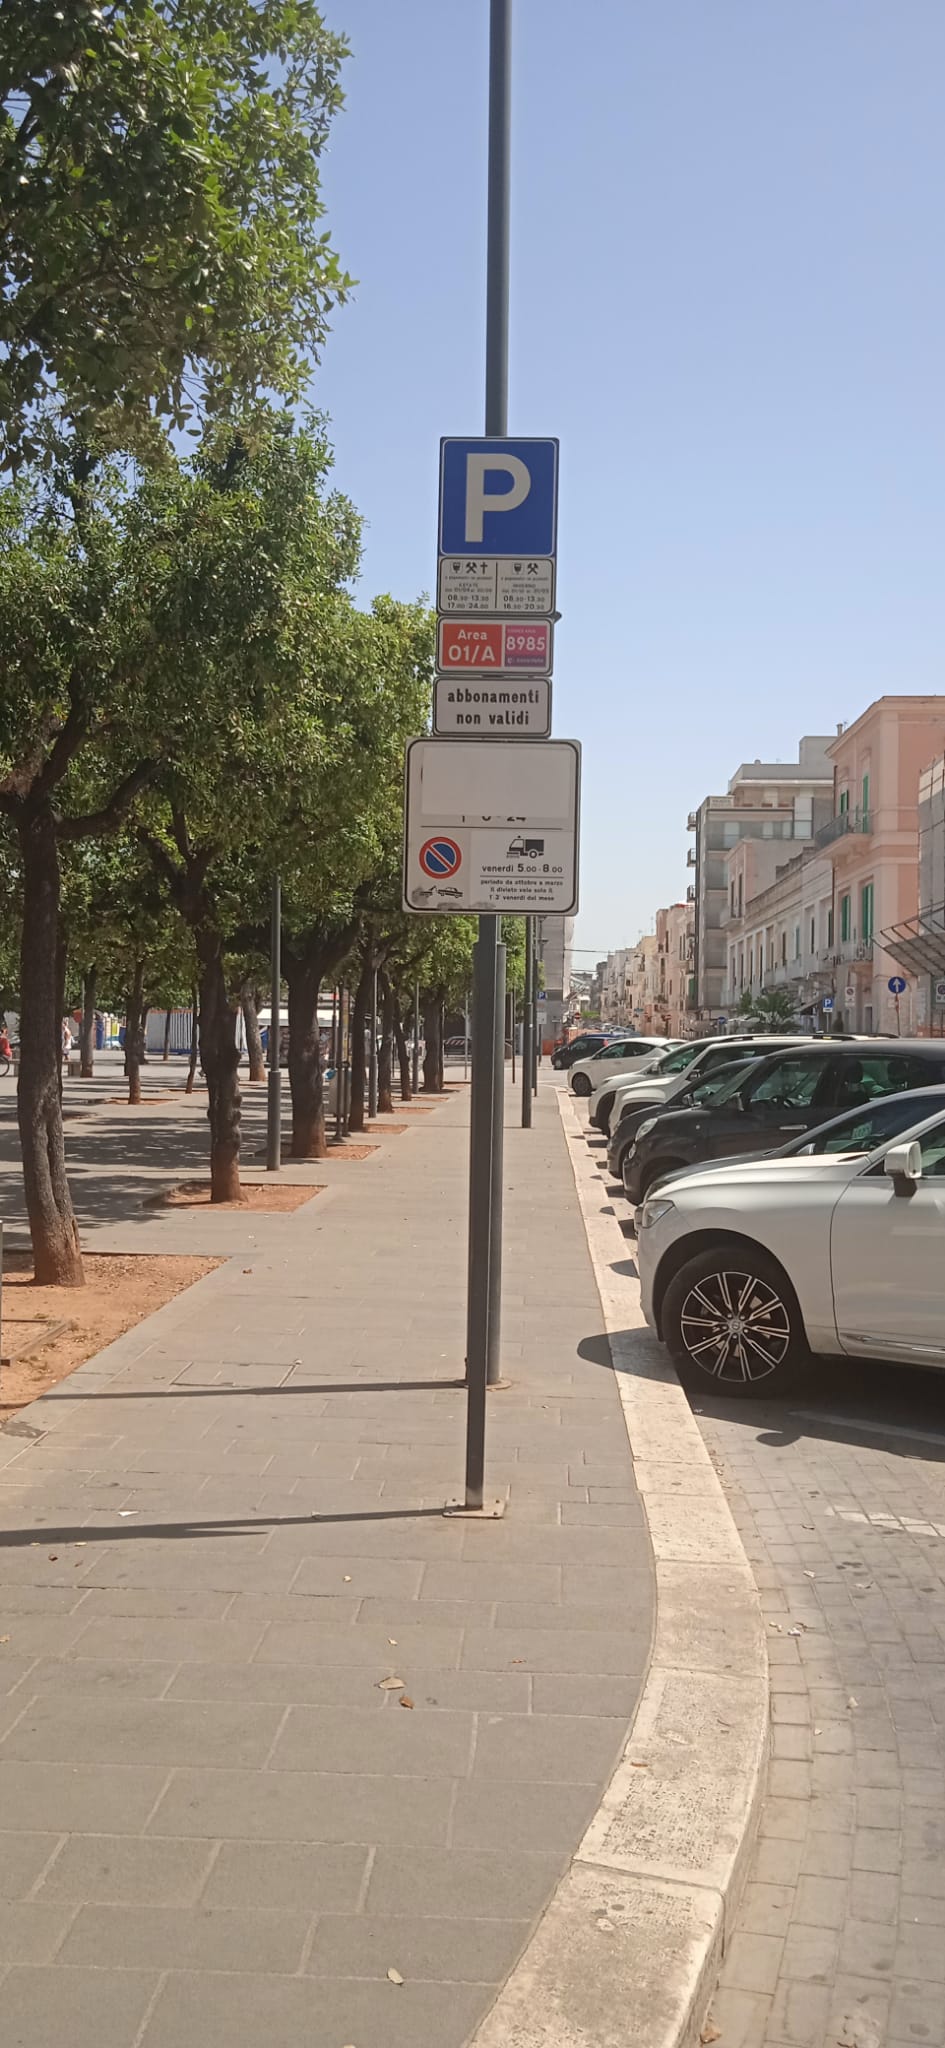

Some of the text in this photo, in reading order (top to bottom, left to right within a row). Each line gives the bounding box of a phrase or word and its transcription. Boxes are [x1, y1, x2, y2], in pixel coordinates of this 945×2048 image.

[465, 453, 531, 542] P
[457, 629, 488, 640] Area
[506, 636, 546, 651] 8985
[447, 688, 539, 703] abbonamenti
[456, 711, 529, 725] non validi
[824, 998, 831, 1007] P
